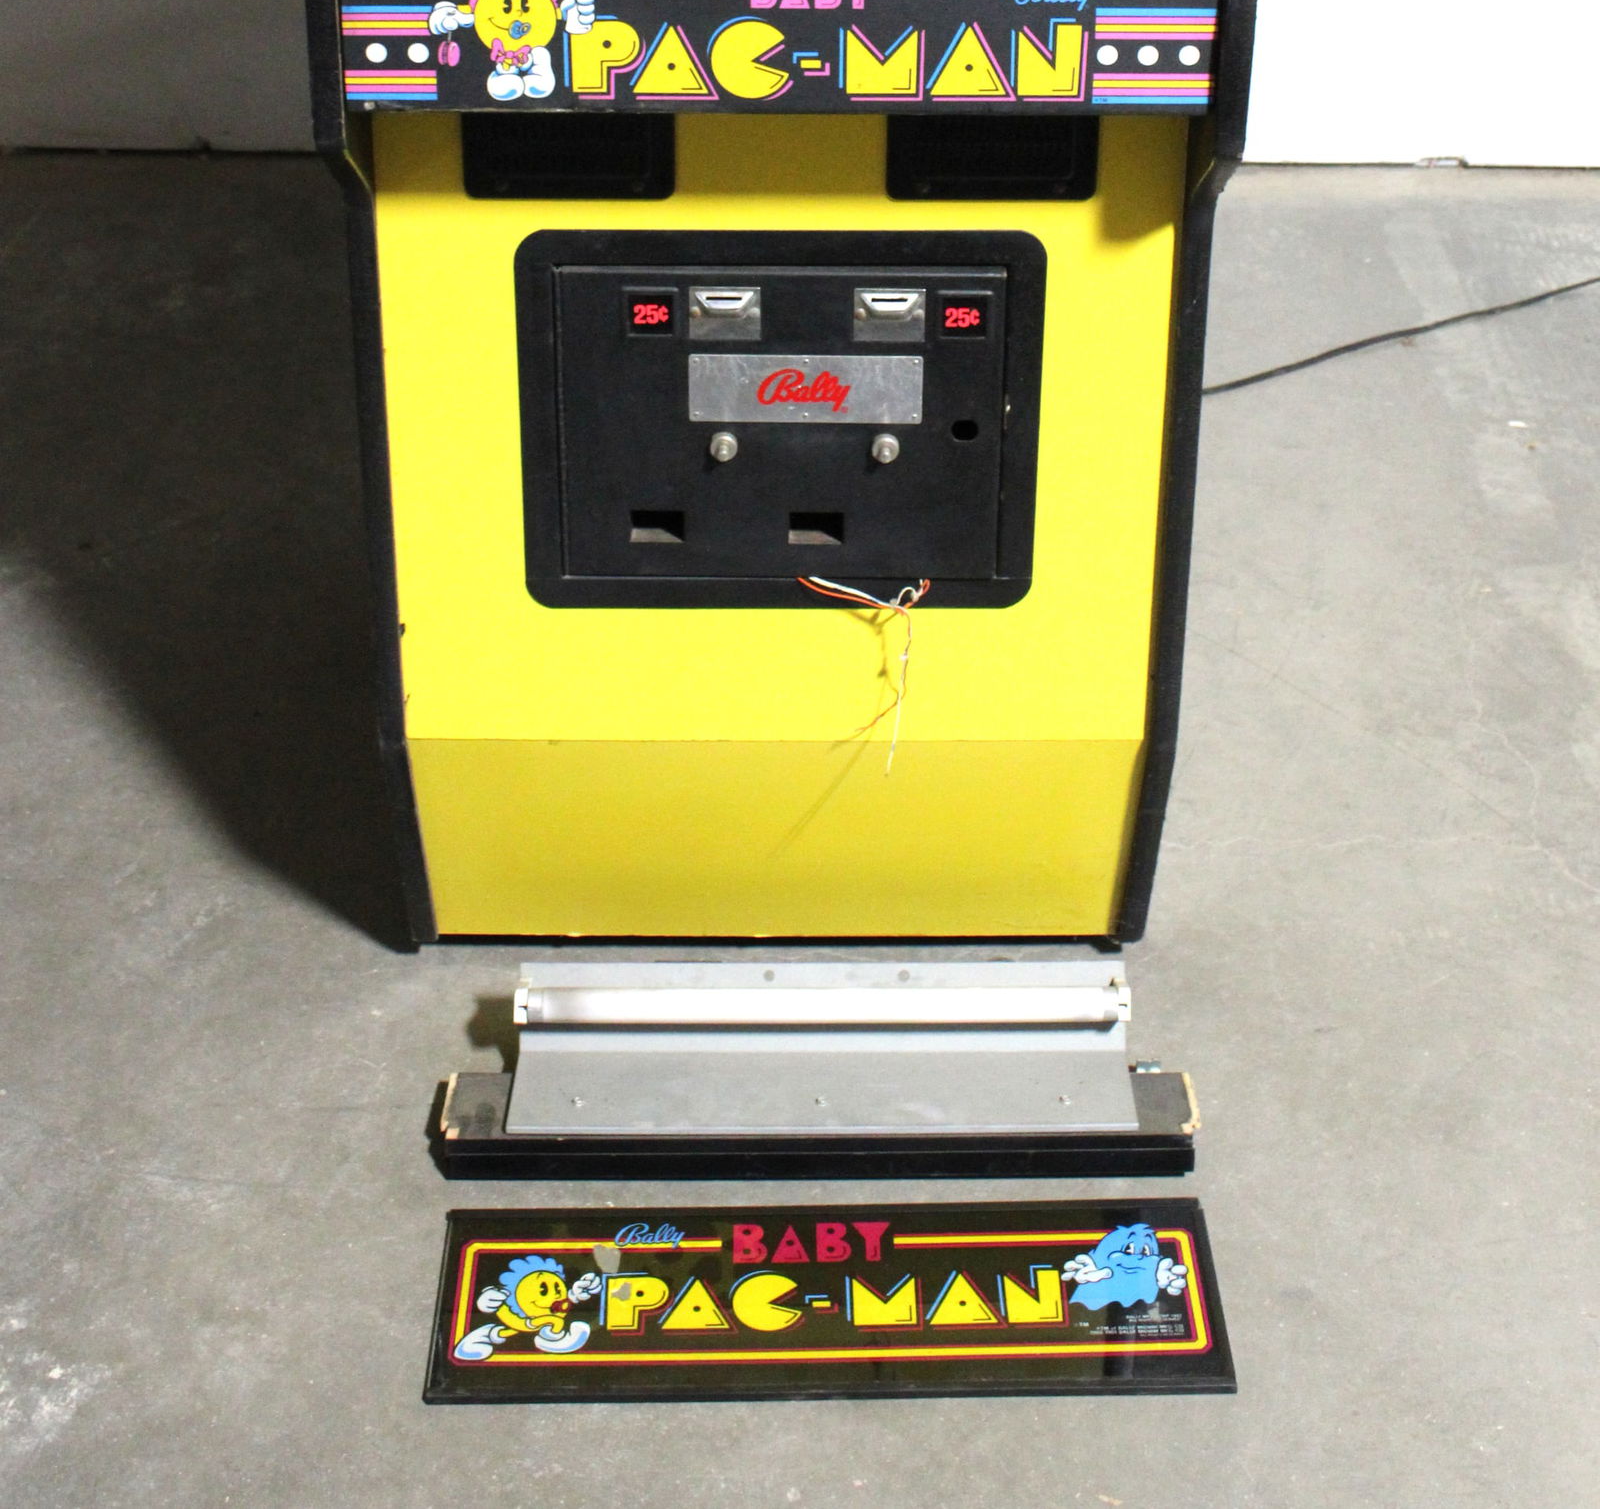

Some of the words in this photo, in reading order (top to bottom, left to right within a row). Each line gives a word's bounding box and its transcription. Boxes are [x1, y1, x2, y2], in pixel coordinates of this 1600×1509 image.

[563, 15, 1089, 102] PAC-MAN
[633, 304, 669, 325] 25¢
[944, 307, 981, 328] 25¢
[757, 368, 851, 412] Bally
[614, 1222, 685, 1248] Bally
[732, 1222, 890, 1264] BABY
[600, 1265, 1069, 1336] PAC-MAN
